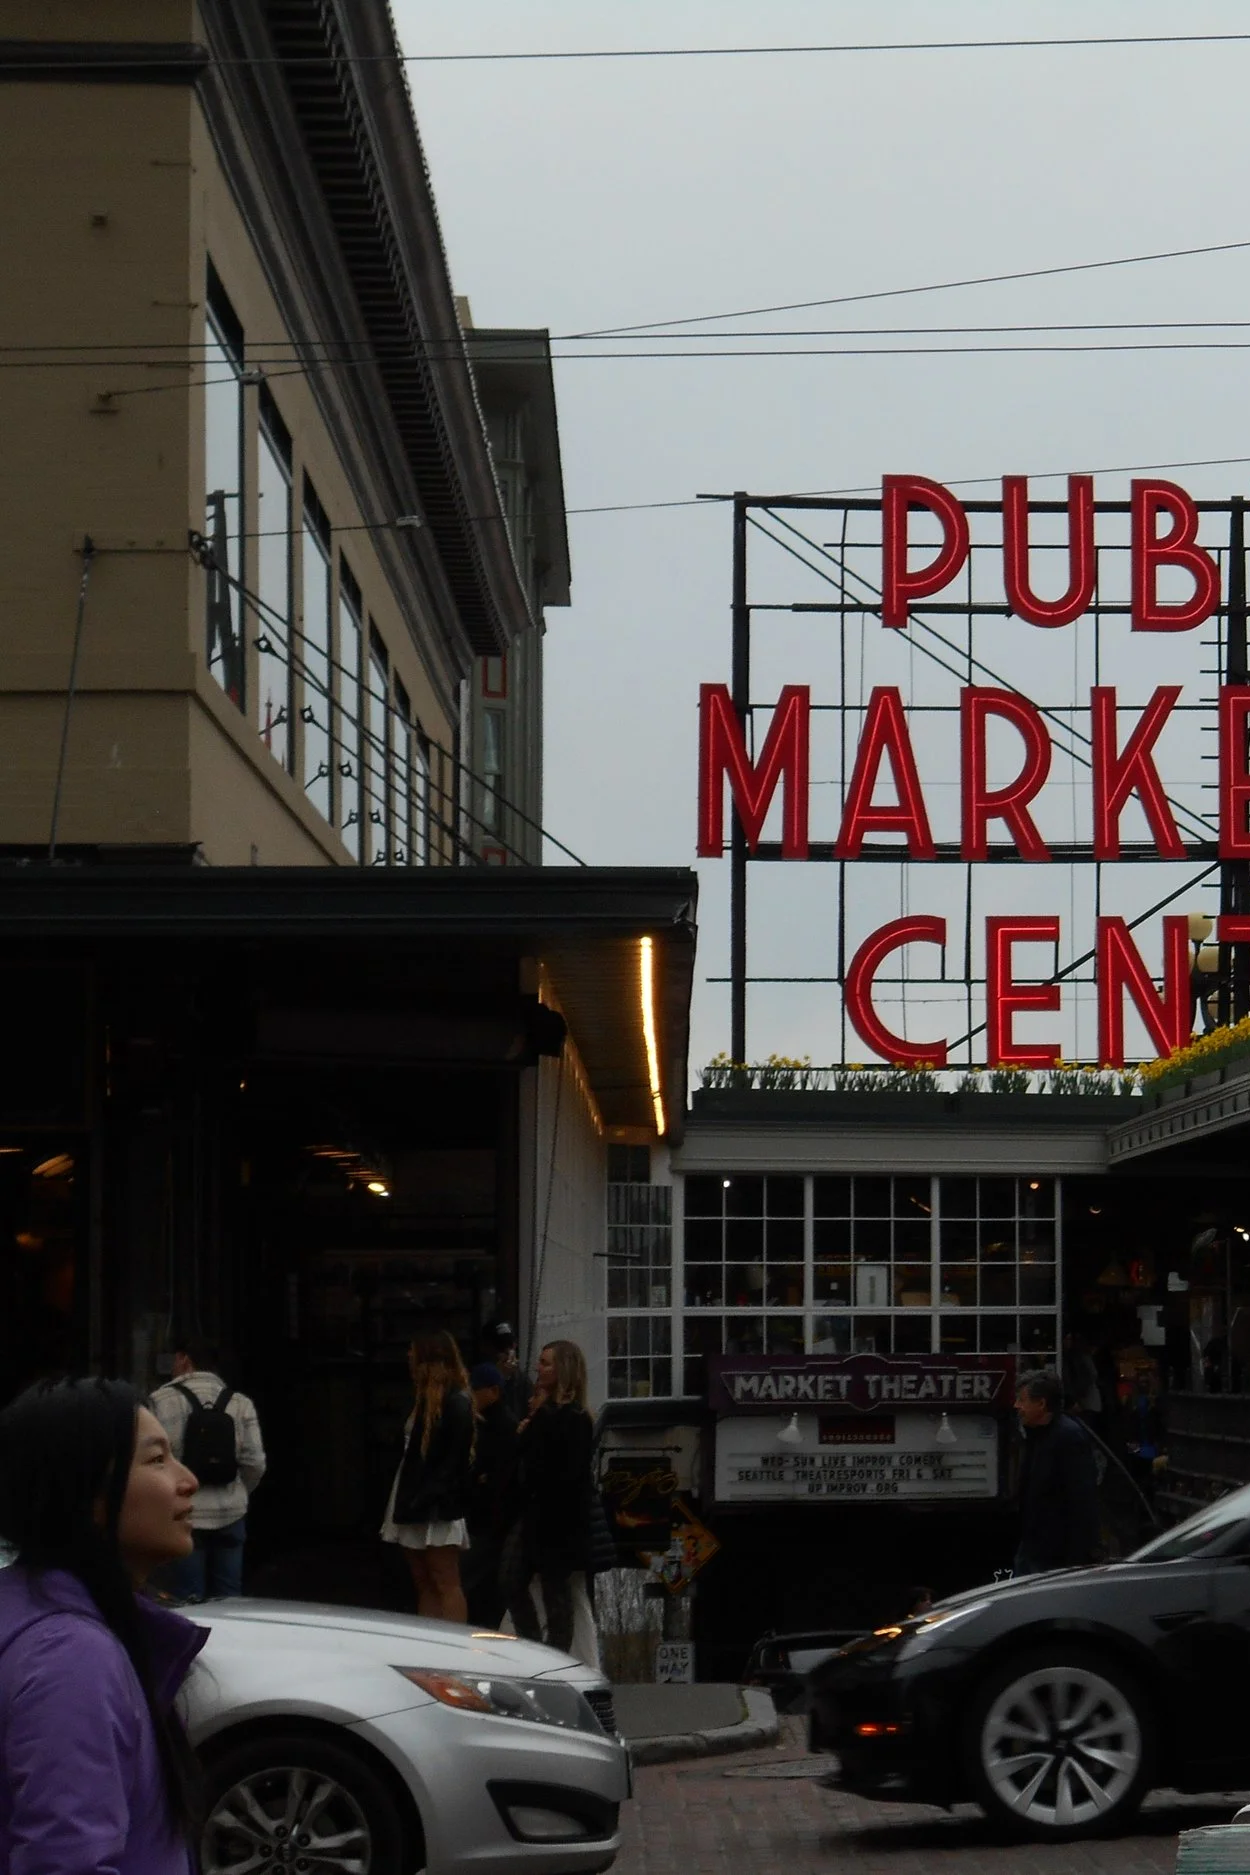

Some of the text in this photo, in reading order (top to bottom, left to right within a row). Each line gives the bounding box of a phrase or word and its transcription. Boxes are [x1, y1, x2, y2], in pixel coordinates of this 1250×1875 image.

[732, 1373, 993, 1400] MARKET THEATER
[822, 1456, 846, 1467] LIVE
[852, 1455, 892, 1466] IMPROV
[900, 1455, 944, 1466] COMEDY
[738, 1470, 784, 1481] SEATTLE
[795, 1469, 886, 1481] THEATRESPORTS
[892, 1469, 910, 1481] FRI
[932, 1469, 953, 1480] SAT
[659, 1647, 688, 1659] ONE
[659, 1663, 688, 1676] WAY
